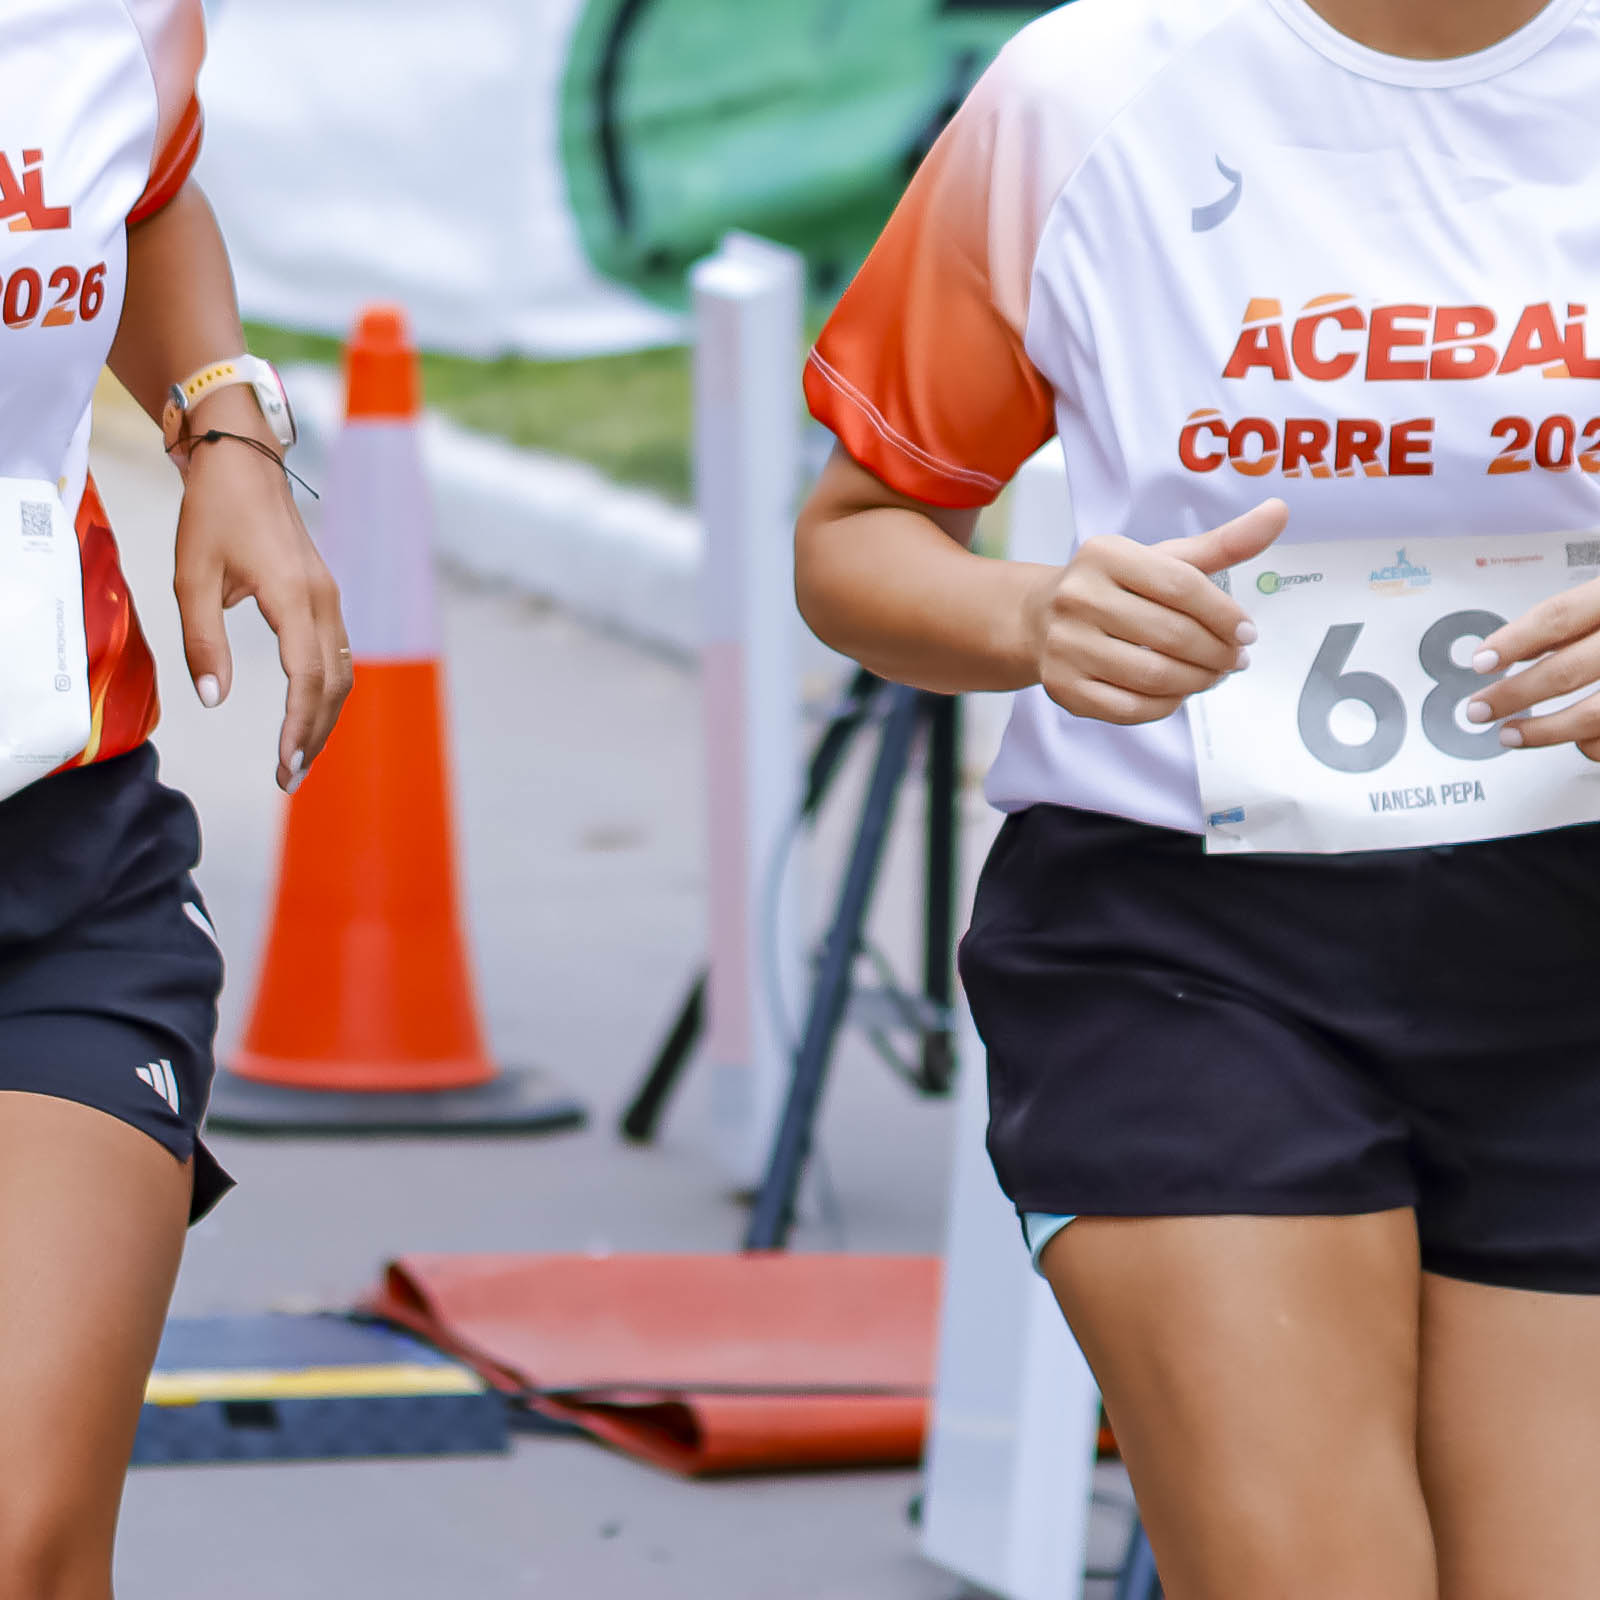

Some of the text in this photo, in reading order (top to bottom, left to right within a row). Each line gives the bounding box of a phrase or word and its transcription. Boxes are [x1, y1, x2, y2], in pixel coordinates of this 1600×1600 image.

[1178, 408, 1435, 478] CORRE
[1298, 609, 1531, 774] 68
[1368, 779, 1486, 813] VANESA PEPA
